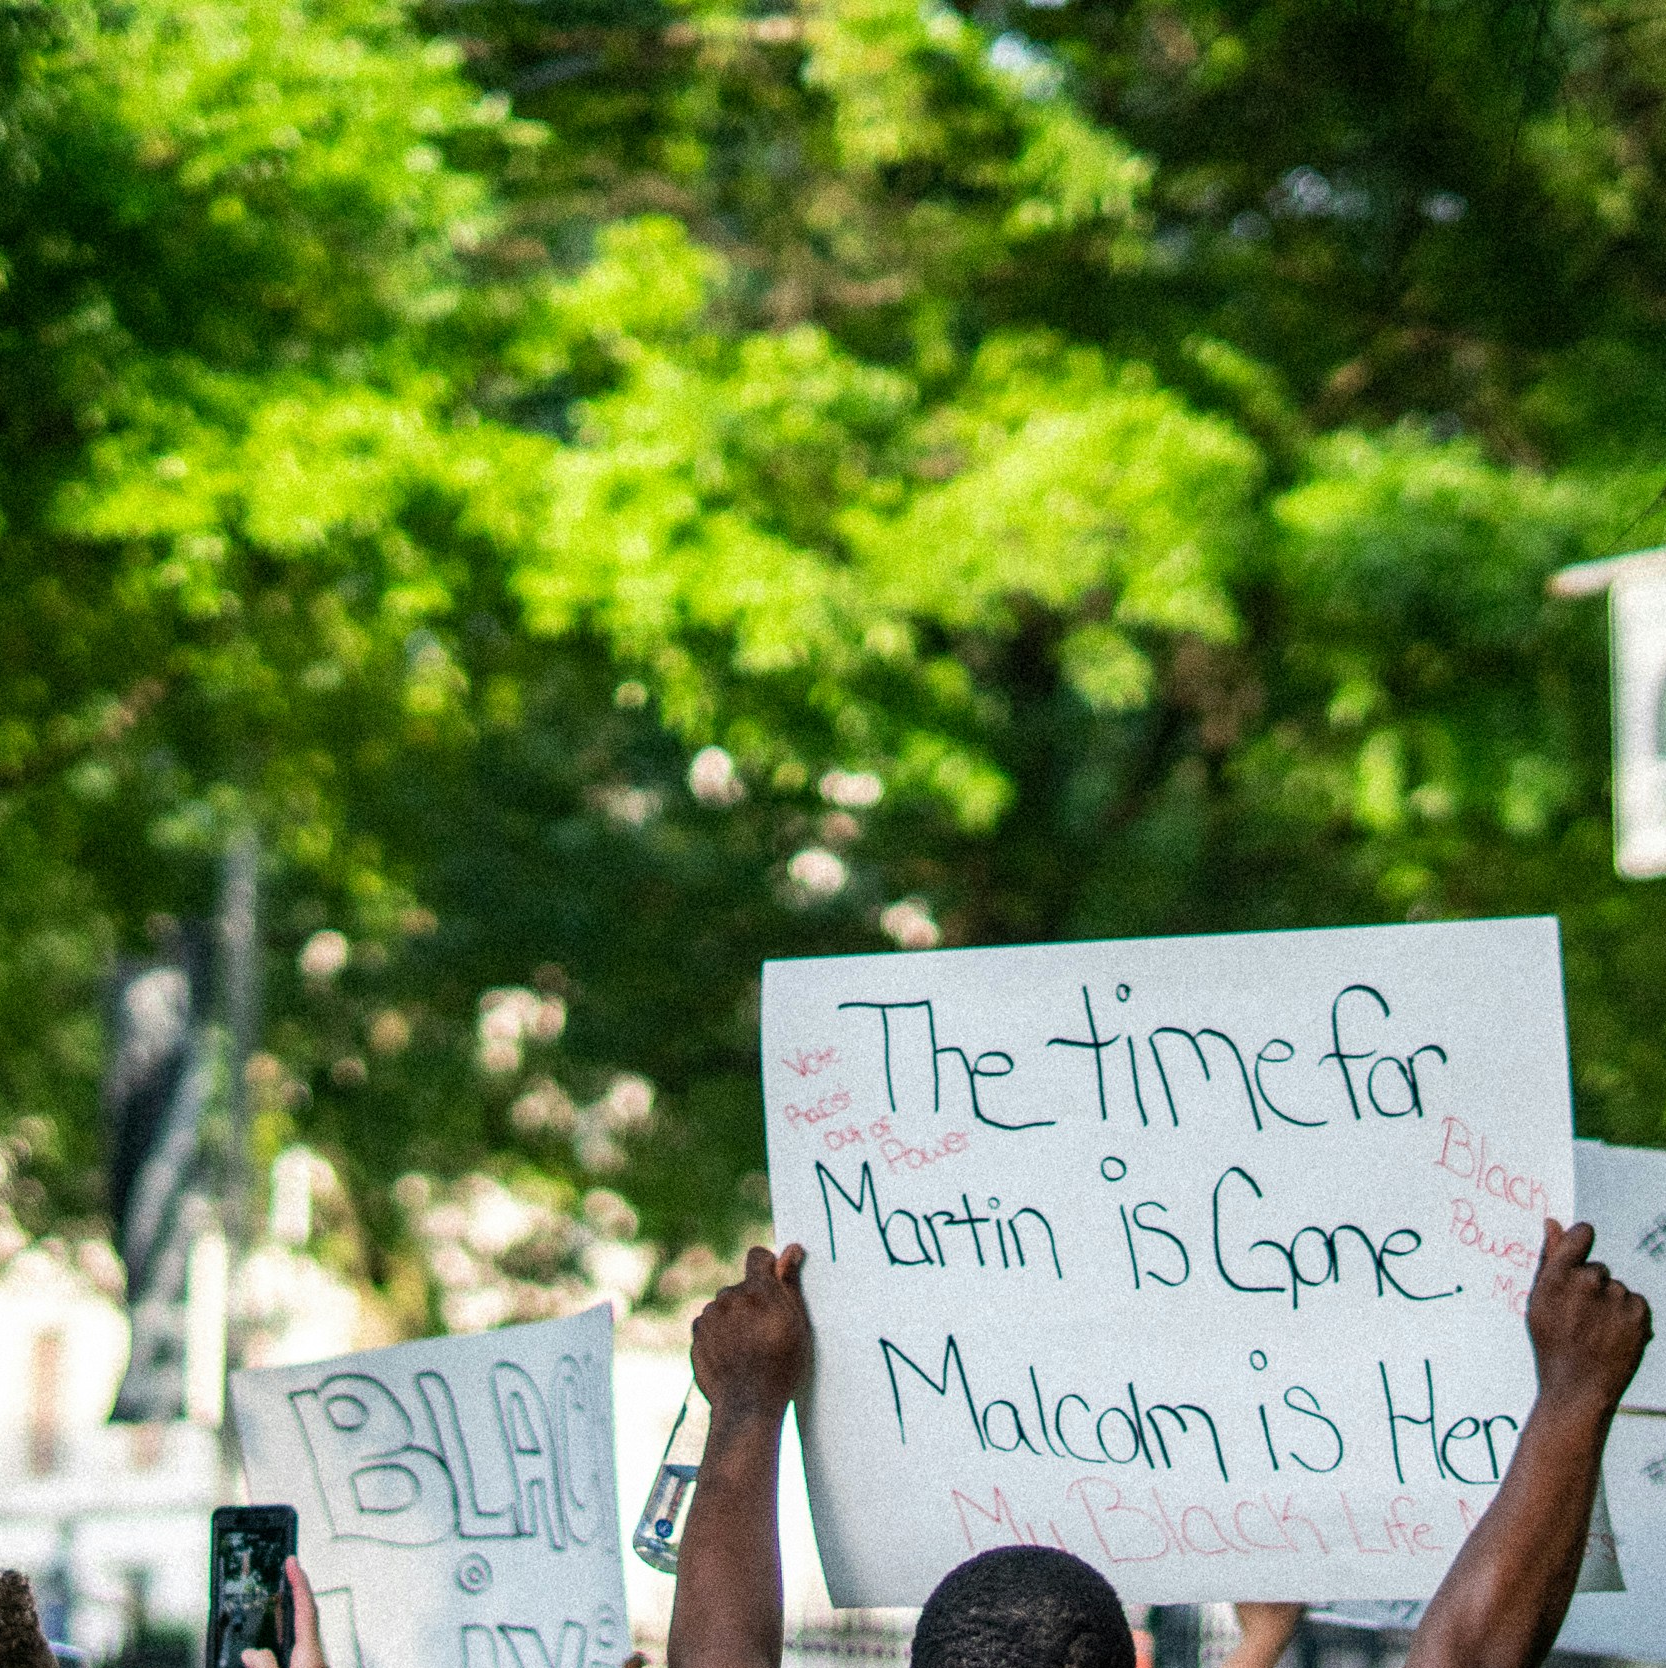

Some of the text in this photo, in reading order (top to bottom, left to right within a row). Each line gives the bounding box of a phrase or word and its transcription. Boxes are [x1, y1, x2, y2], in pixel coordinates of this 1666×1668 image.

[837, 999, 1058, 1131] The
[1045, 982, 1329, 1130] time
[816, 1159, 1063, 1280] Martin
[1100, 1155, 1190, 1290] is
[1433, 1115, 1550, 1219] Black
[287, 1352, 603, 1550] BLAC
[878, 1333, 1520, 1485] Malcolm is Her
[1065, 1475, 1330, 1564] Black
[1338, 1490, 1445, 1559] Life
